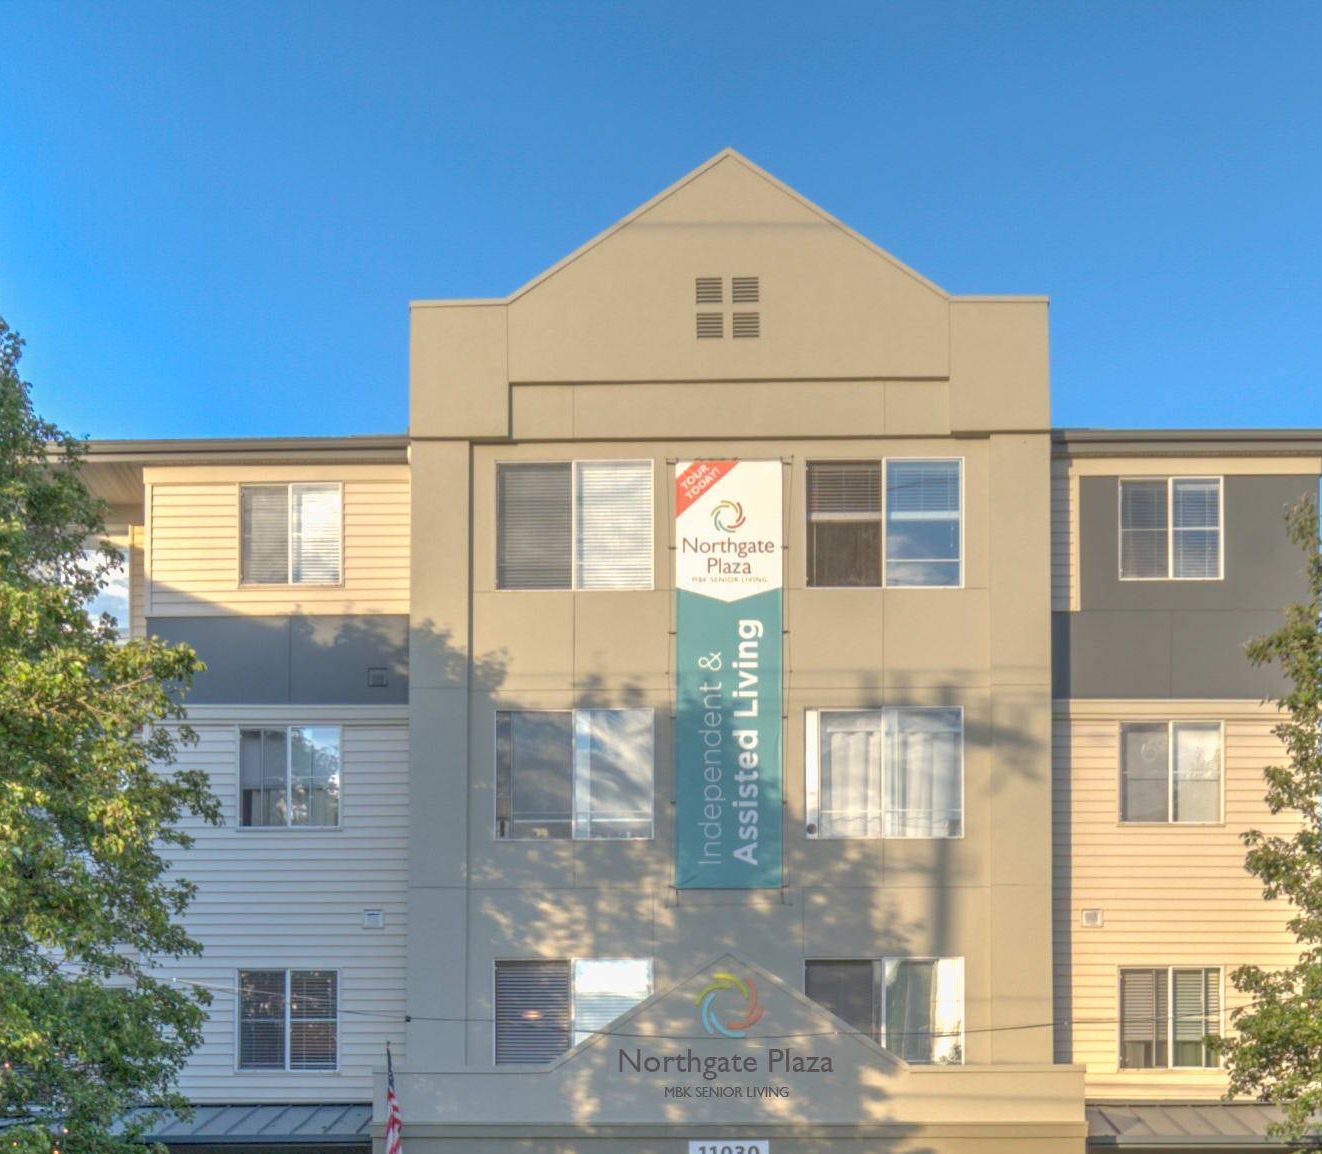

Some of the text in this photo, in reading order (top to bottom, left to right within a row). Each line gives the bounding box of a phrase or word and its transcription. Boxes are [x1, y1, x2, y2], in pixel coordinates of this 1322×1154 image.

[680, 464, 710, 490] TOUR
[684, 467, 722, 499] TODAY!
[682, 537, 775, 558] Northgate
[707, 557, 752, 574] Plaza
[732, 619, 764, 865] Assisted Living
[698, 651, 725, 865] Independent &
[618, 1048, 835, 1081] Northgate Plaza
[664, 1086, 790, 1098] MBK SENIOR LIVING
